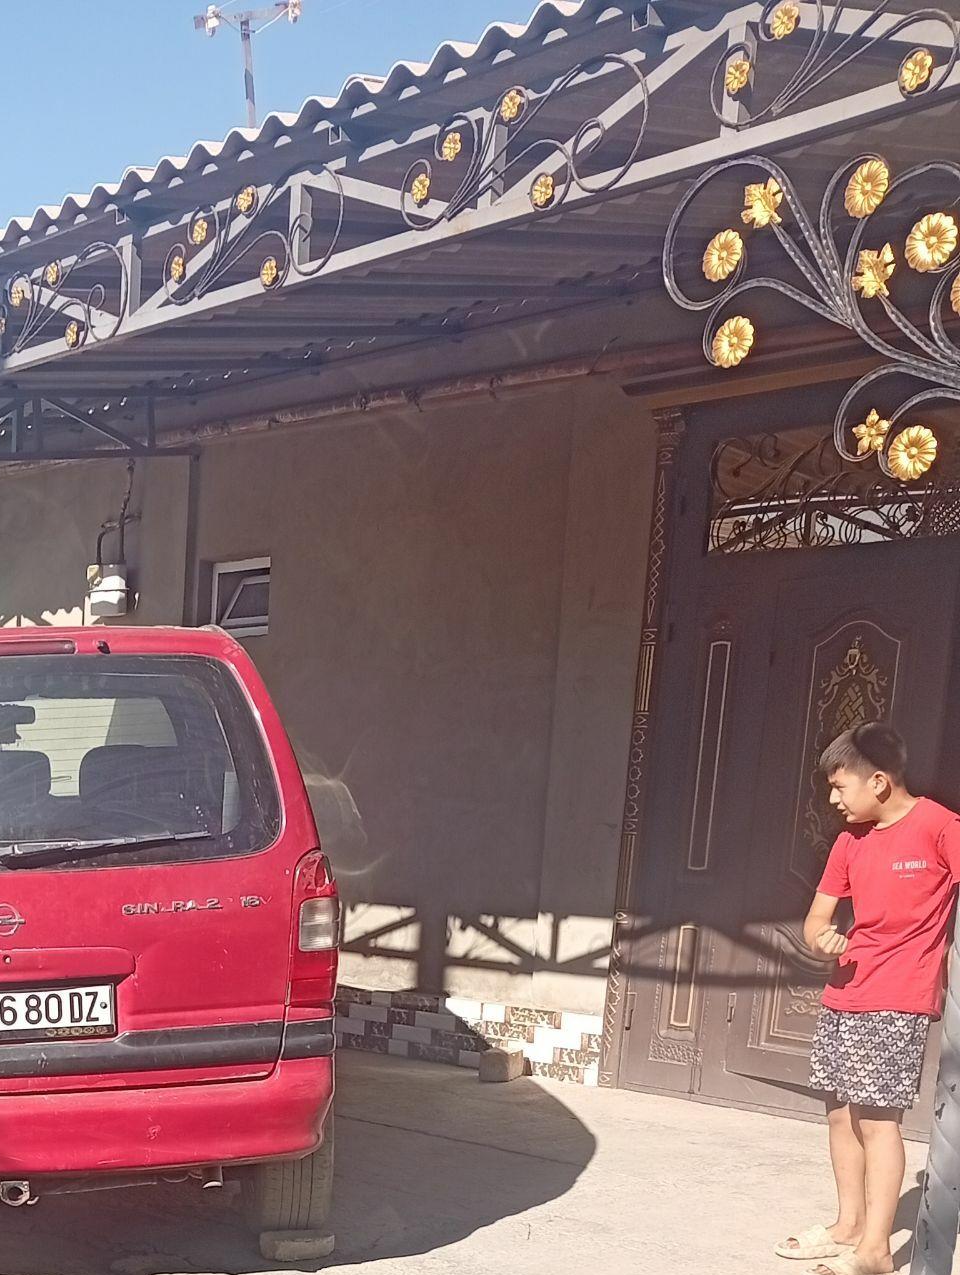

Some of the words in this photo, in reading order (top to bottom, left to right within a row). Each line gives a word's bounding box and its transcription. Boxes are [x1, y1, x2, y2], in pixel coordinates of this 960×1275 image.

[904, 860, 927, 869] WORLD
[24, 993, 63, 1025] 80
[69, 991, 100, 1023] DZ
